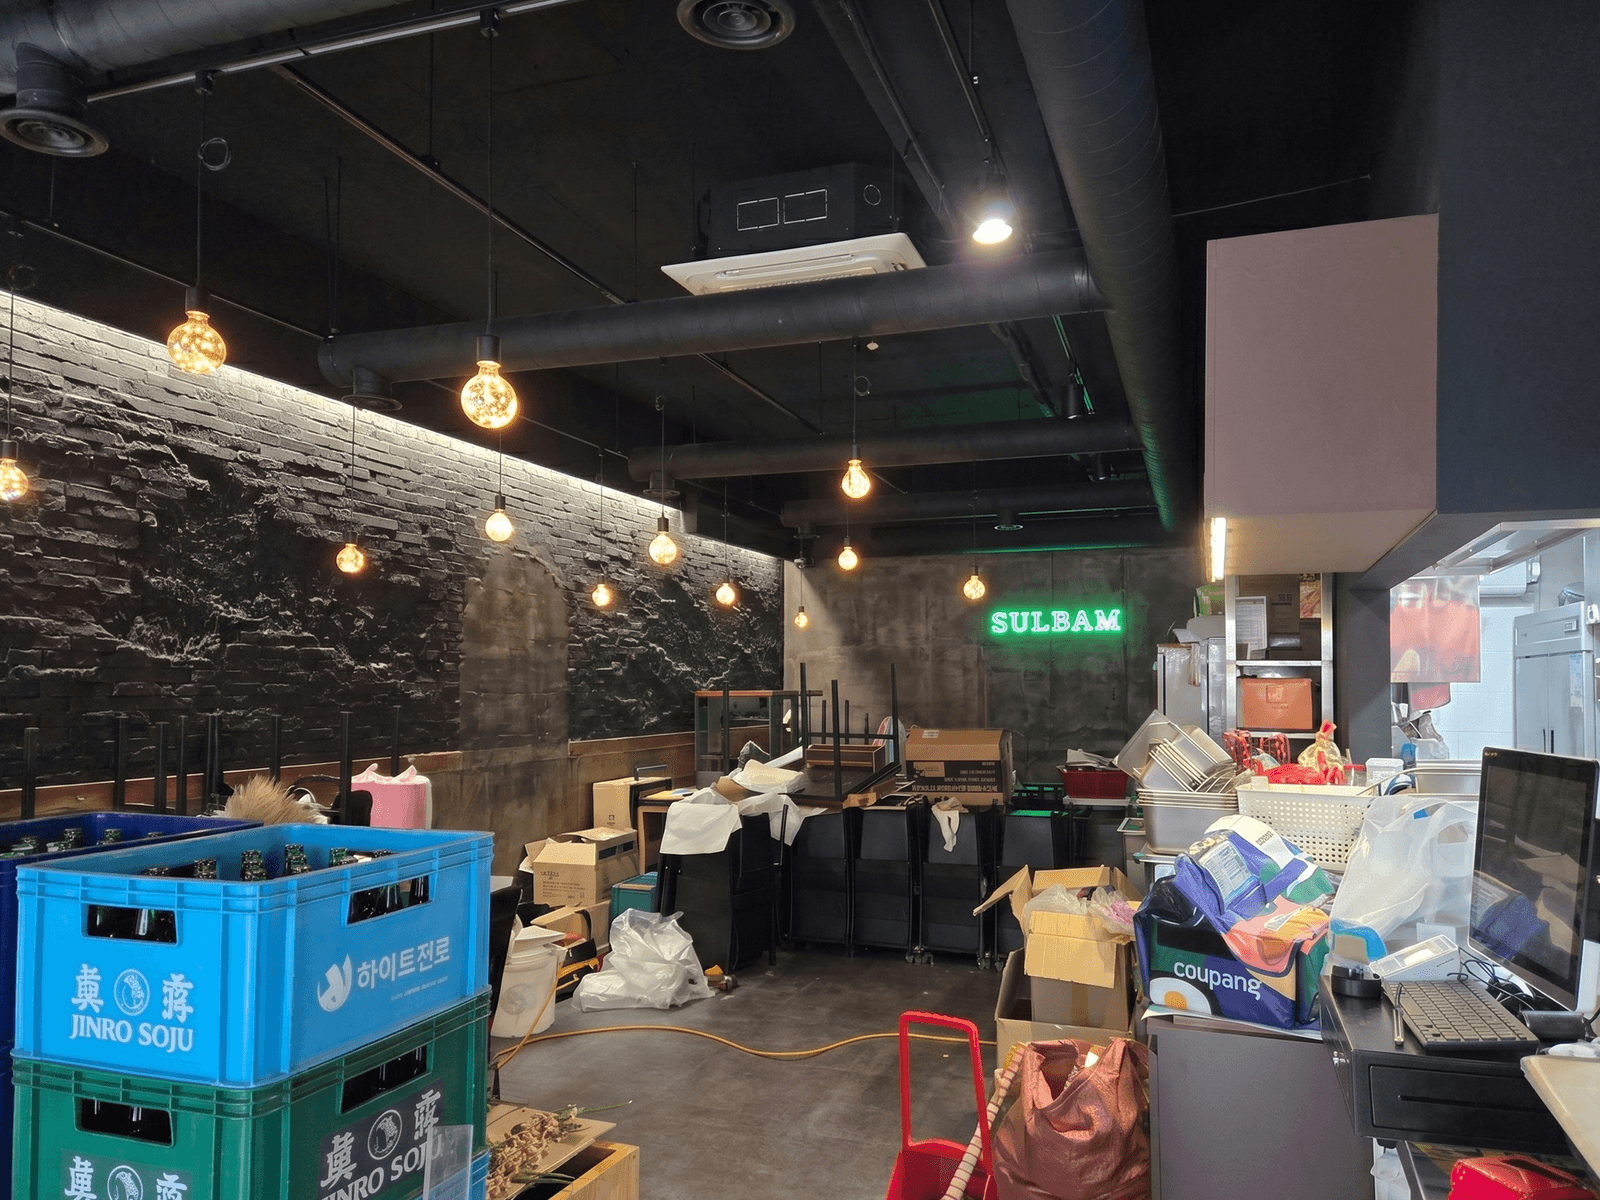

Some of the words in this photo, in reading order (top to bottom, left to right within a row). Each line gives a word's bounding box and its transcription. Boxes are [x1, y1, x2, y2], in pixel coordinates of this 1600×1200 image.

[991, 609, 1122, 634] SULBAM
[1173, 961, 1262, 1001] coupang
[69, 1014, 133, 1043] JINRO
[138, 1022, 194, 1053] SOJU
